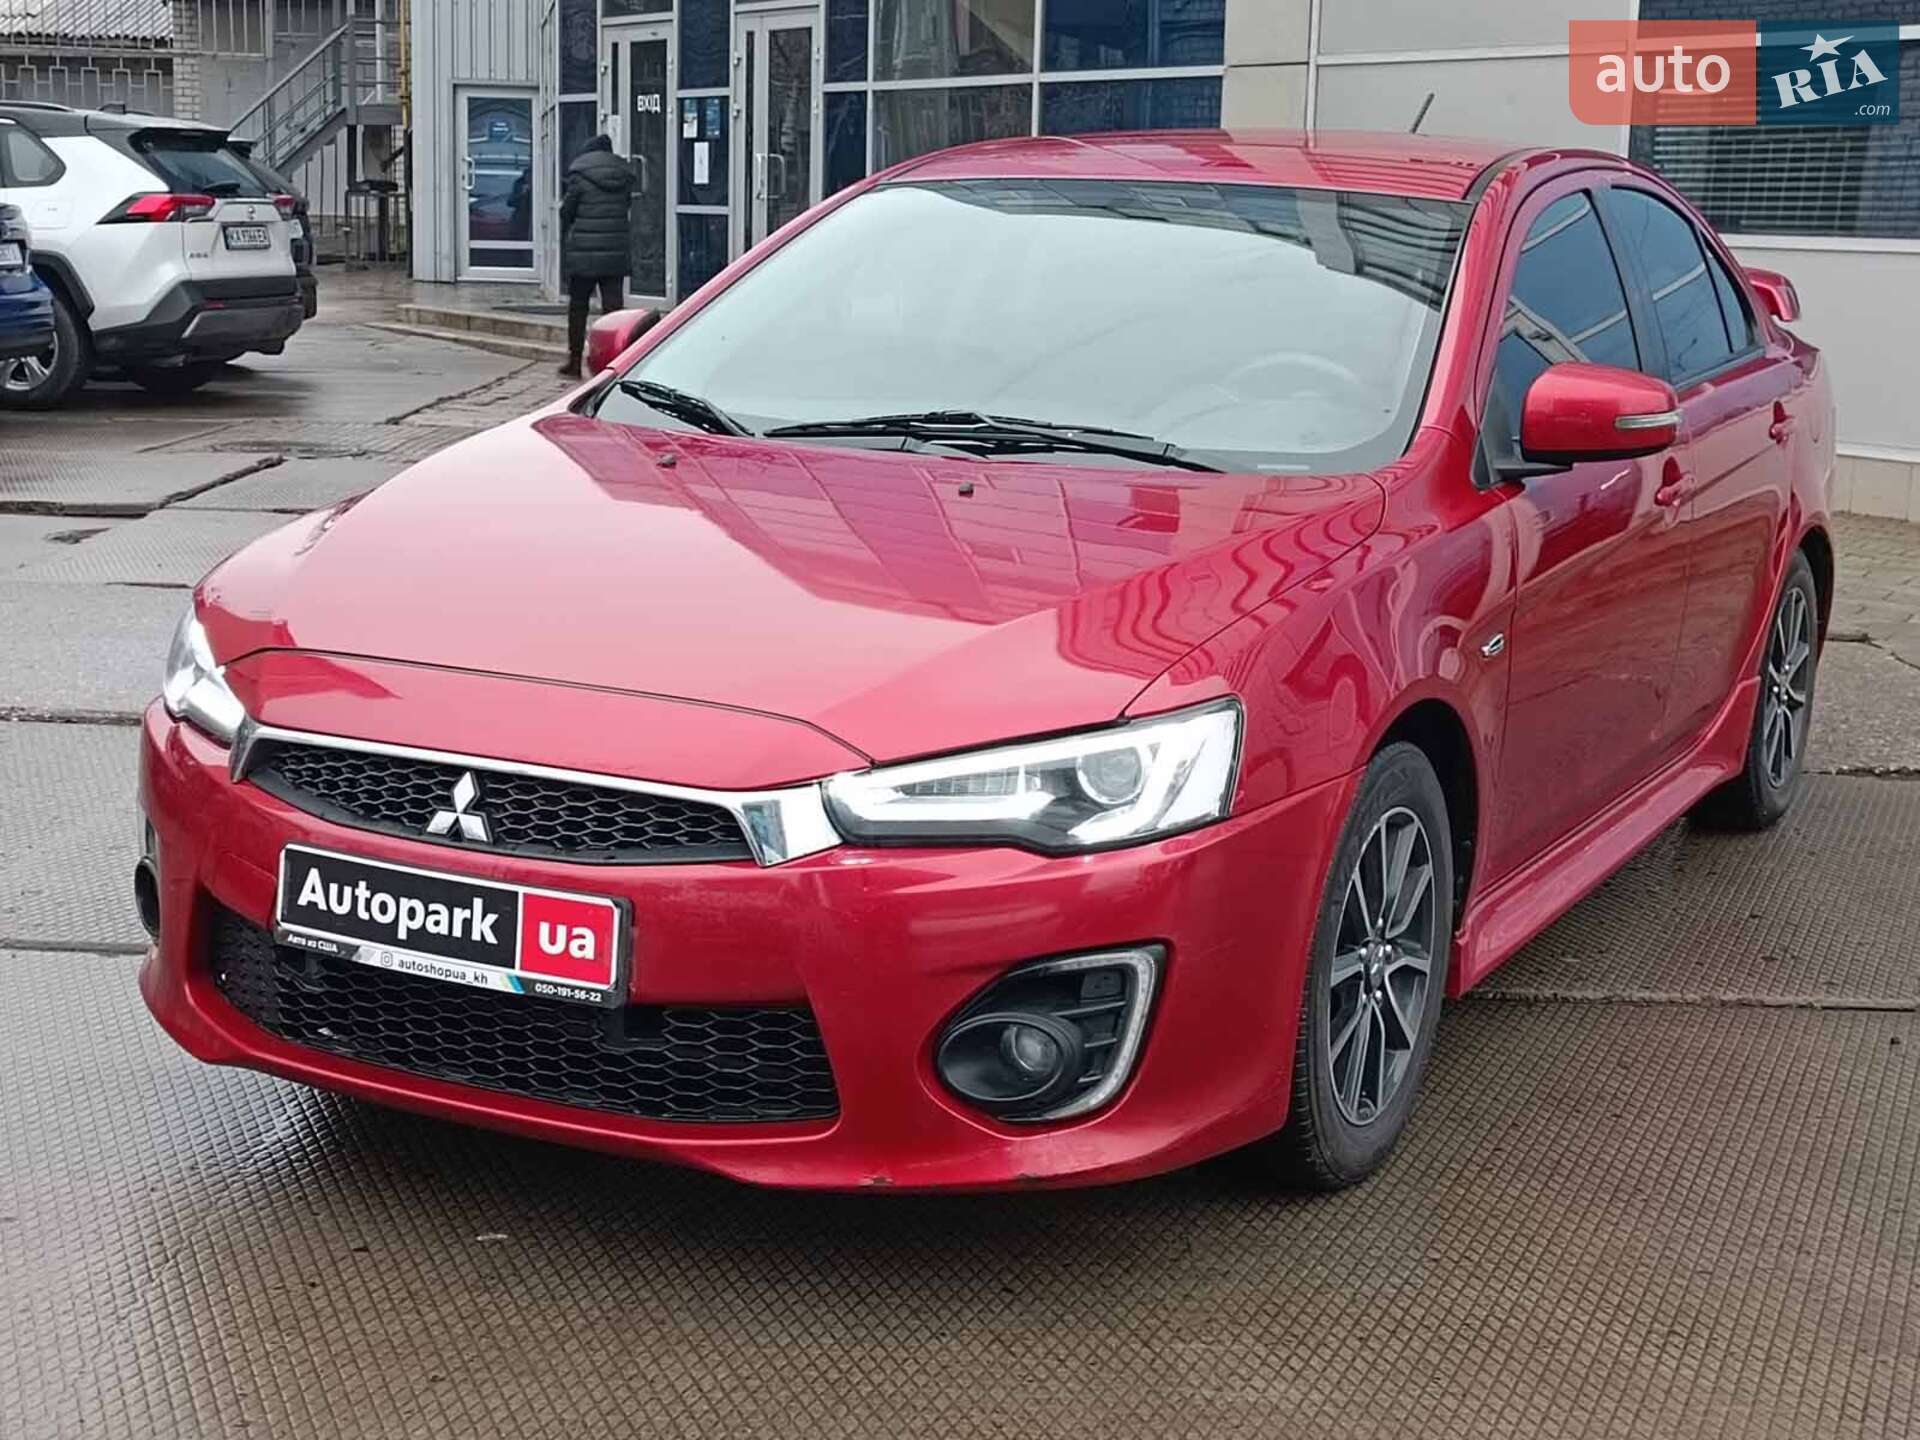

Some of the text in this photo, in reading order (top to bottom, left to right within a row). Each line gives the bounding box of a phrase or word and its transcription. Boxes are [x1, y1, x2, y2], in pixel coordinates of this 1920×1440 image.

[637, 93, 661, 113] ВХІД
[296, 866, 596, 960] Autopark ua
[318, 941, 338, 953] США
[398, 957, 489, 985] autoshopua_kh
